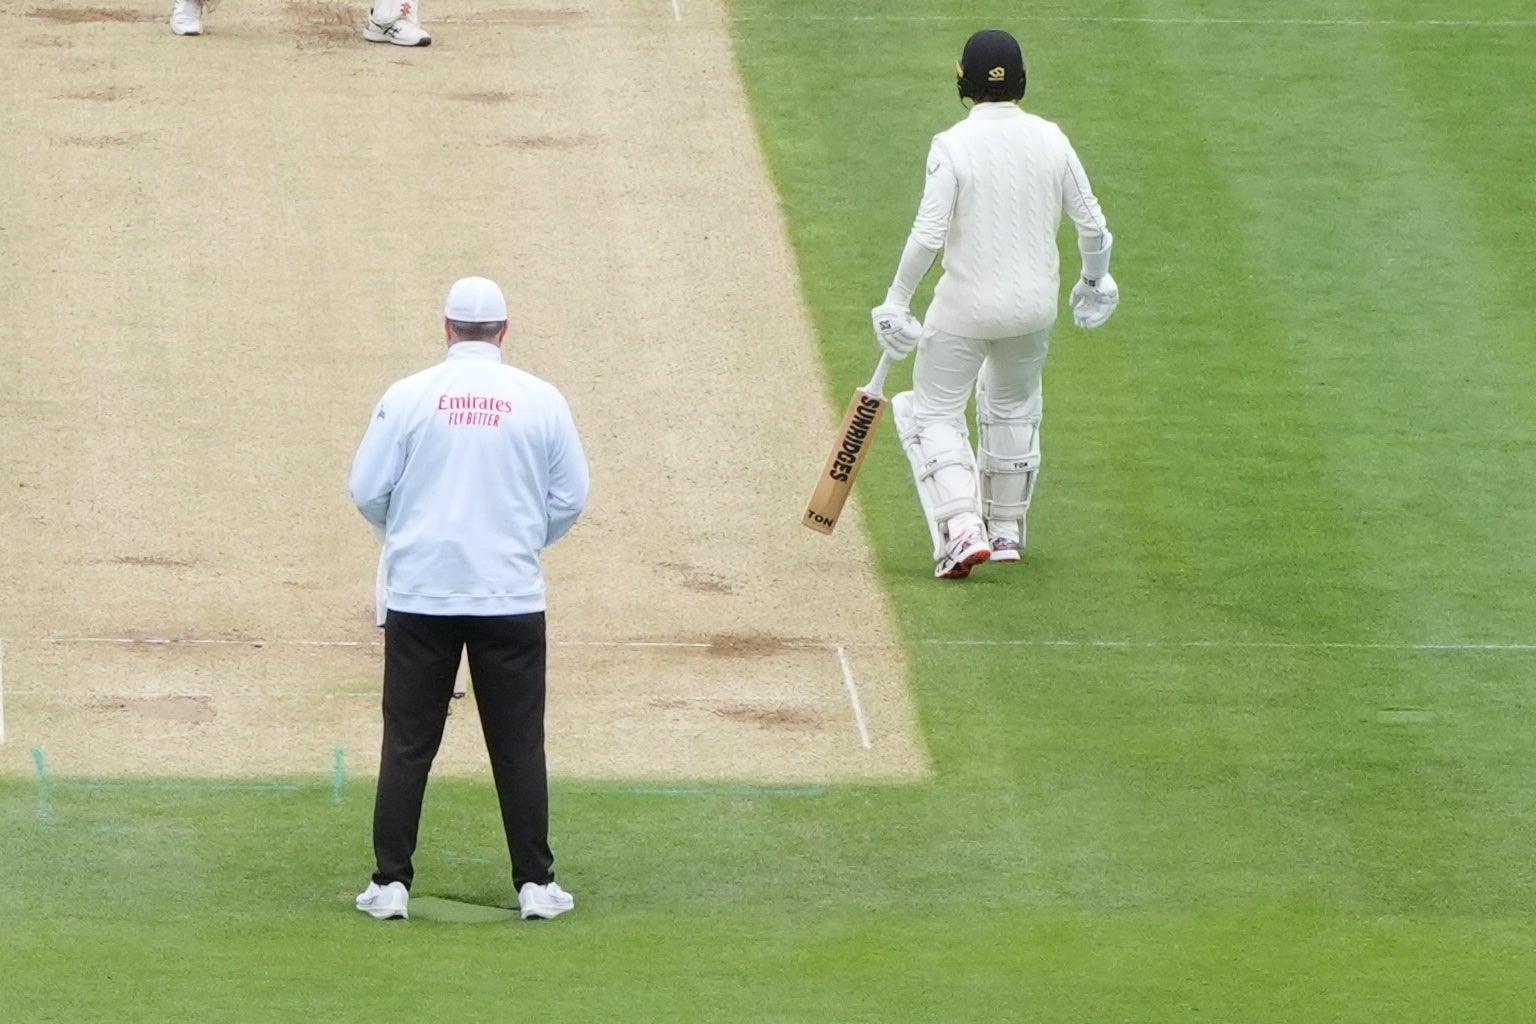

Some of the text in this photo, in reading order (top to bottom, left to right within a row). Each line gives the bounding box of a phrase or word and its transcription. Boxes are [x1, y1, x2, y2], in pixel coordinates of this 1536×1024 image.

[438, 393, 512, 413] Emirates
[449, 412, 500, 427] FLY BETTER
[829, 395, 880, 483] SUNRIDGES
[808, 510, 834, 527] TON
